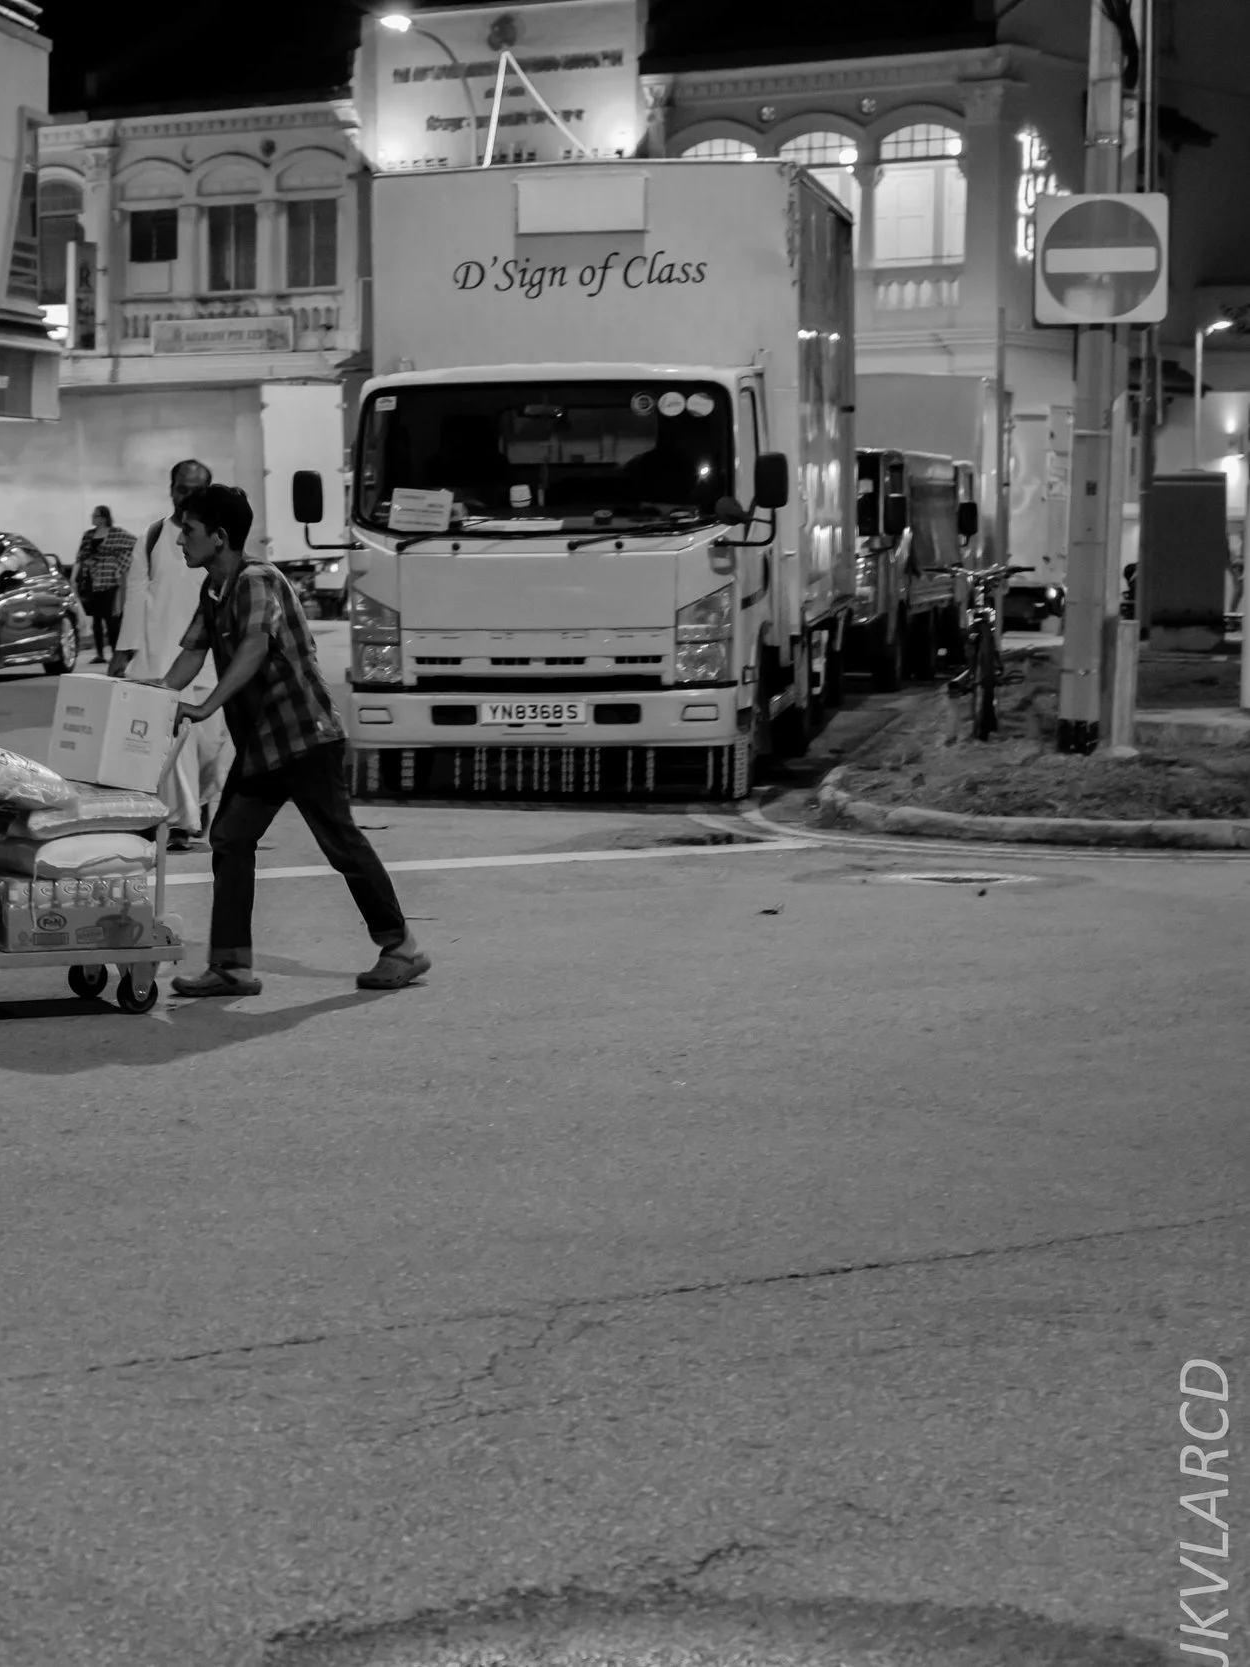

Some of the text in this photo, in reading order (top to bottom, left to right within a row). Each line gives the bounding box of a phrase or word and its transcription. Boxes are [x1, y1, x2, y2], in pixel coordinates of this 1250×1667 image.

[453, 250, 708, 299] D'Sign of Class
[489, 704, 578, 720] YN8368S
